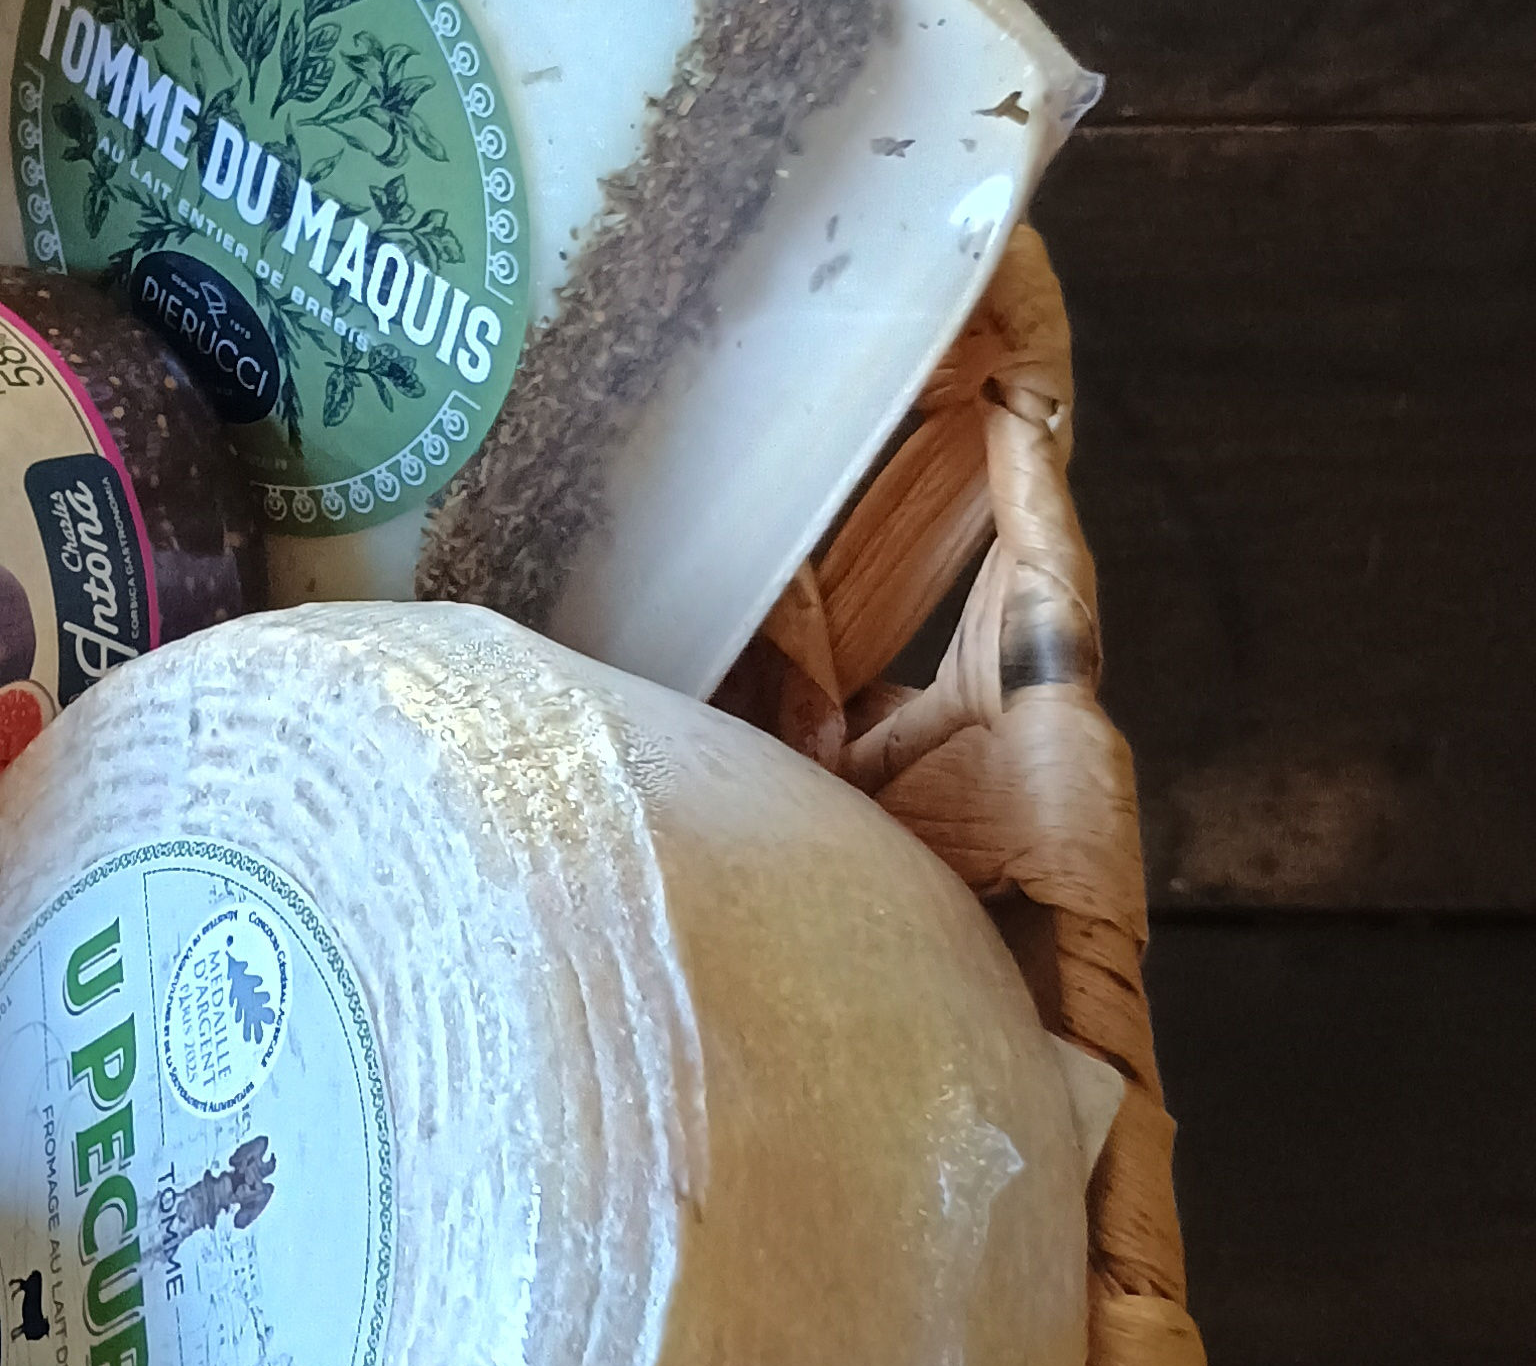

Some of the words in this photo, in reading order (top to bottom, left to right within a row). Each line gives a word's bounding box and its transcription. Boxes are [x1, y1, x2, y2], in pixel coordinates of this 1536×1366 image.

[97, 135, 125, 164] AU
[129, 157, 173, 200] LAIT
[177, 198, 249, 262] ENTIER
[255, 259, 286, 290] DE
[290, 289, 372, 354] BREBIS
[201, 118, 279, 225] DU
[283, 179, 502, 383] MAQUIS
[50, 490, 83, 573] Charles
[62, 480, 139, 679] Antona
[61, 916, 125, 1015] U
[194, 957, 217, 1088] D'ARGENT
[184, 1041, 199, 1084] 2025
[41, 1103, 61, 1229] FROMAGE
[50, 1236, 63, 1276] AU
[158, 1162, 184, 1303] TOMME
[51, 1281, 68, 1337] LAIT
